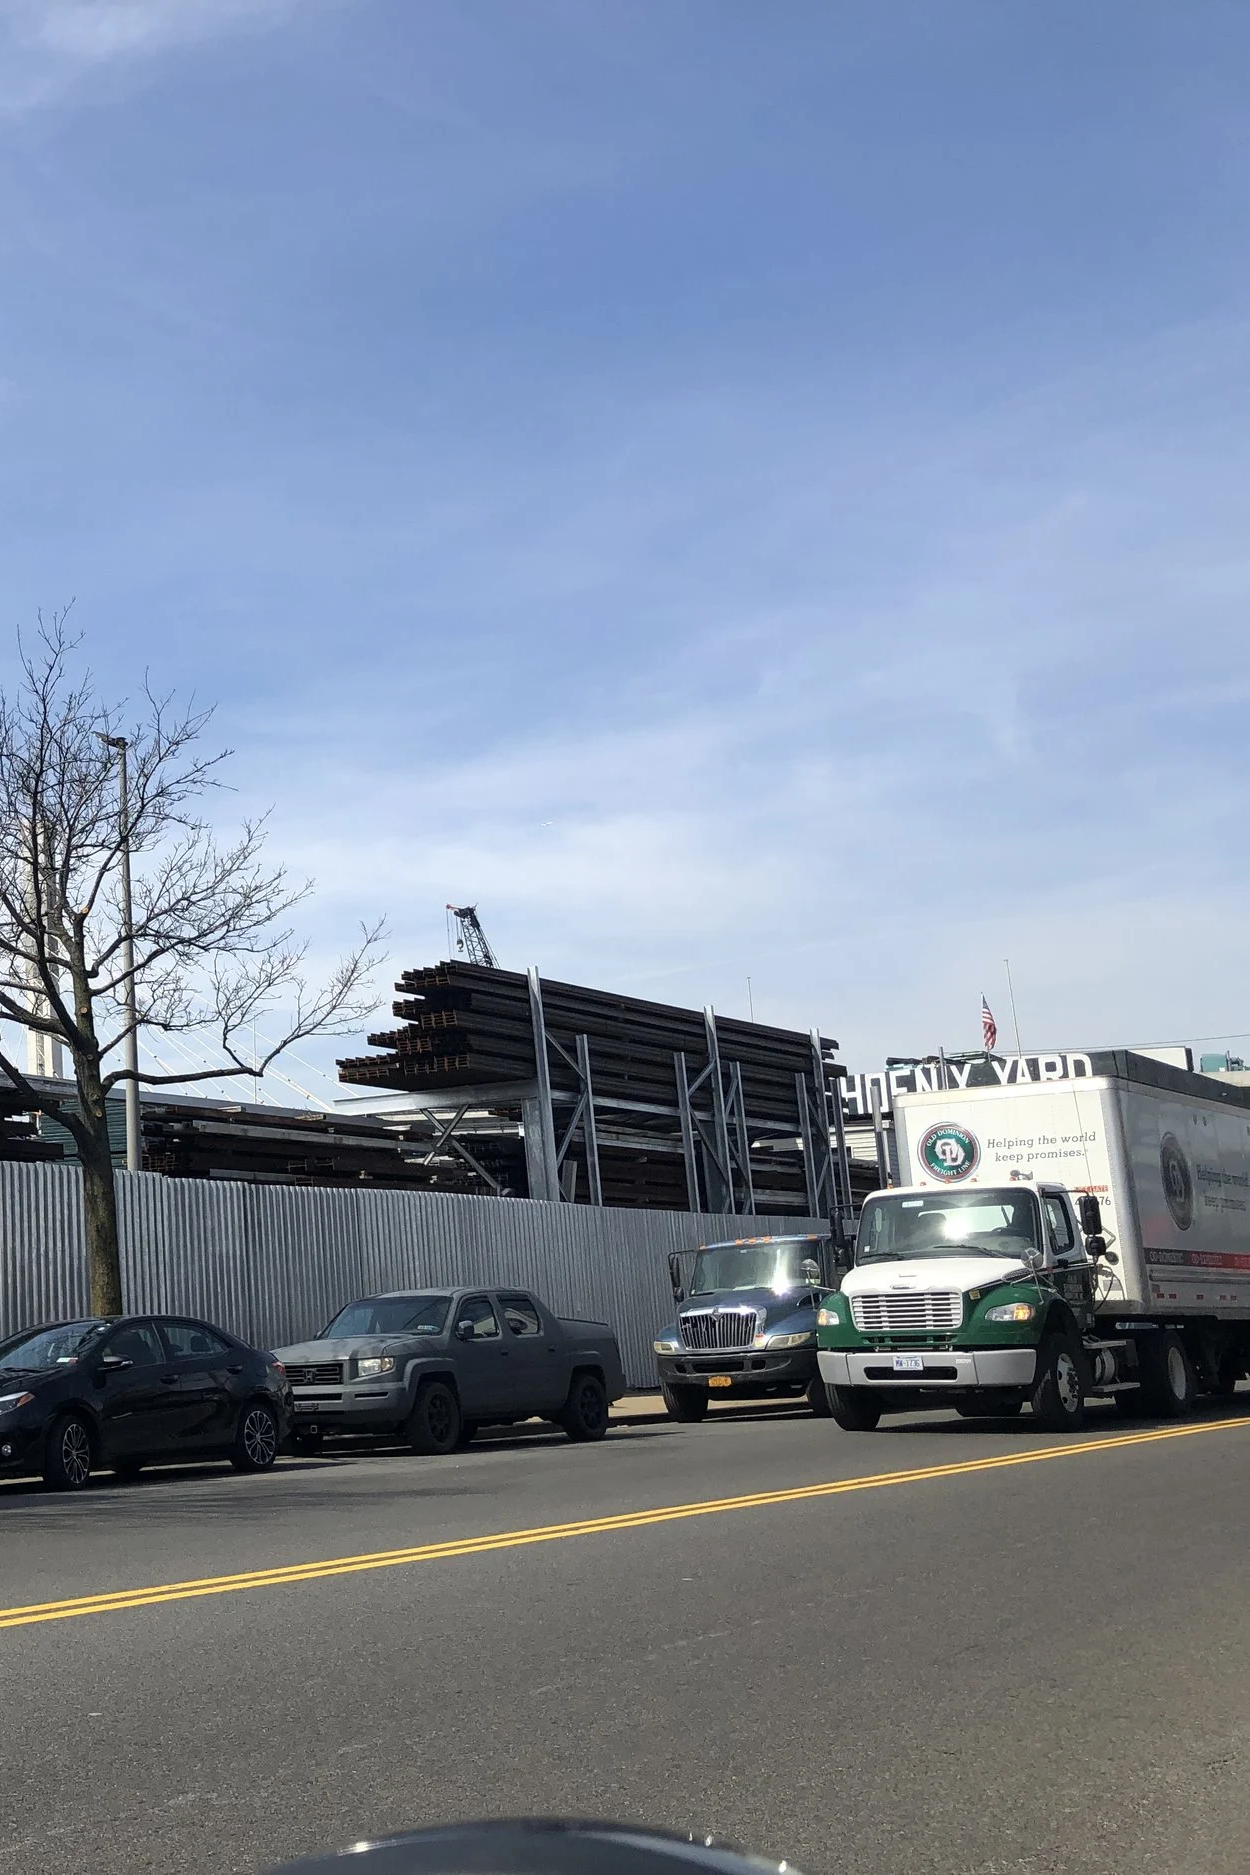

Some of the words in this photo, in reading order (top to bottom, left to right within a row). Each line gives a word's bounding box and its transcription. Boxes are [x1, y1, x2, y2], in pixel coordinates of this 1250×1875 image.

[991, 1053, 1093, 1086] YARD
[987, 1138, 1035, 1149] Helping
[1038, 1135, 1057, 1145] the
[1061, 1131, 1096, 1143] world
[995, 1153, 1024, 1163] keep
